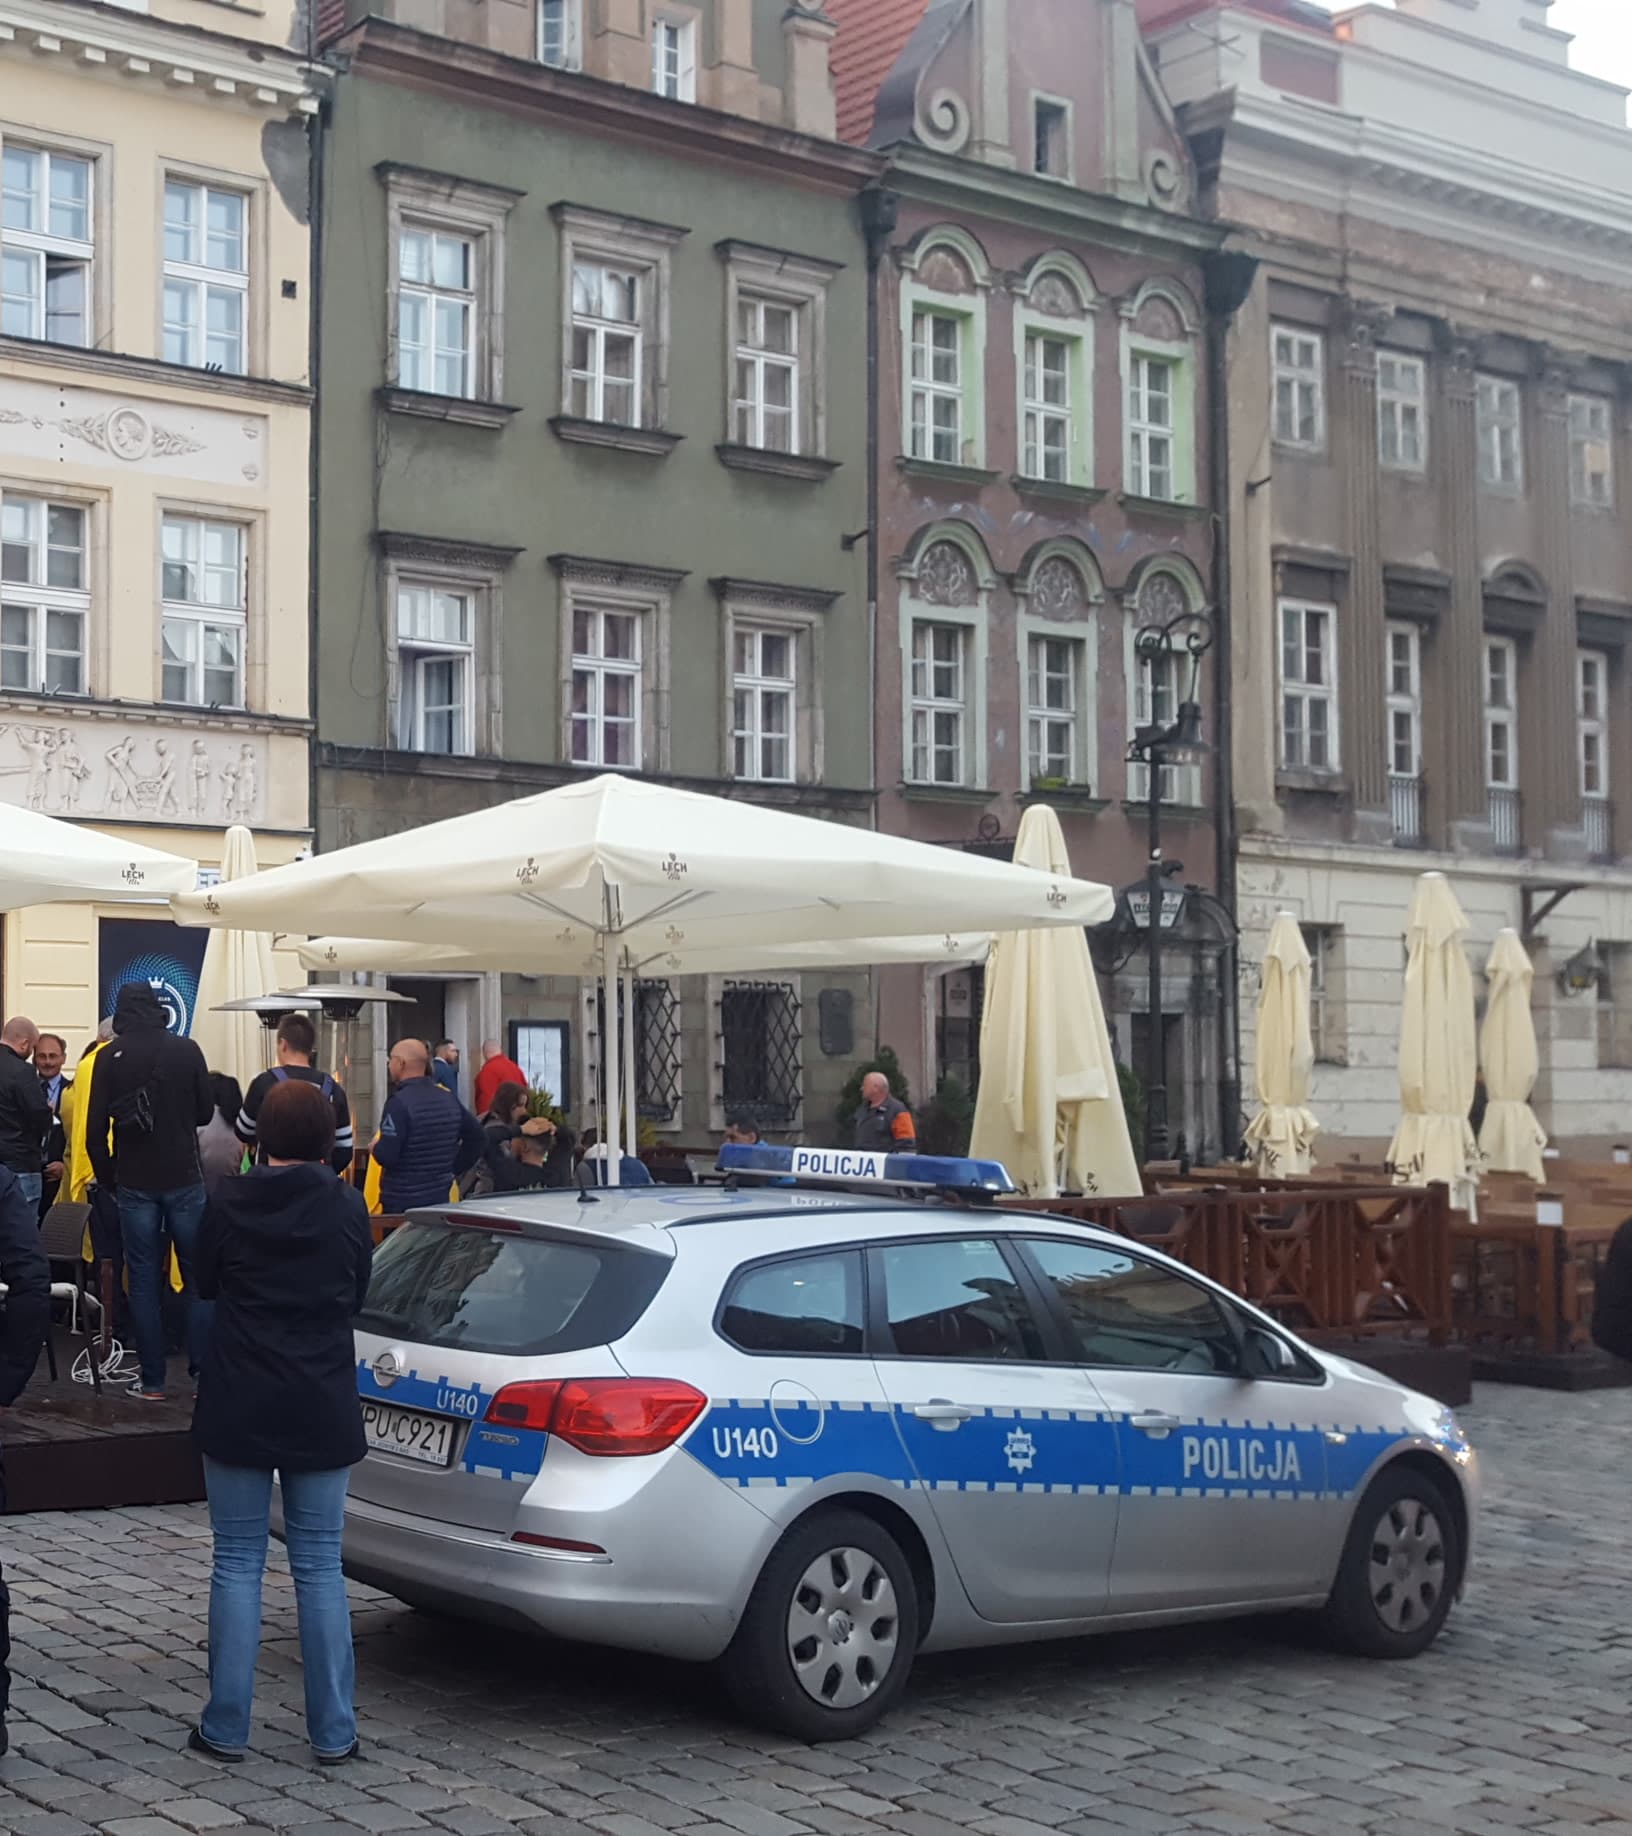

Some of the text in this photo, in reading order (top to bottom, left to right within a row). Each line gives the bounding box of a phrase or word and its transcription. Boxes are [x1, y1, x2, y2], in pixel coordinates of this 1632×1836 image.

[121, 870, 144, 880] LECH
[661, 861, 687, 873] LECH
[797, 1153, 877, 1177] POLICJA
[437, 1388, 478, 1416] U140
[395, 1414, 446, 1454] C921
[713, 1427, 778, 1458] U140
[1183, 1436, 1301, 1481] POLICJA
